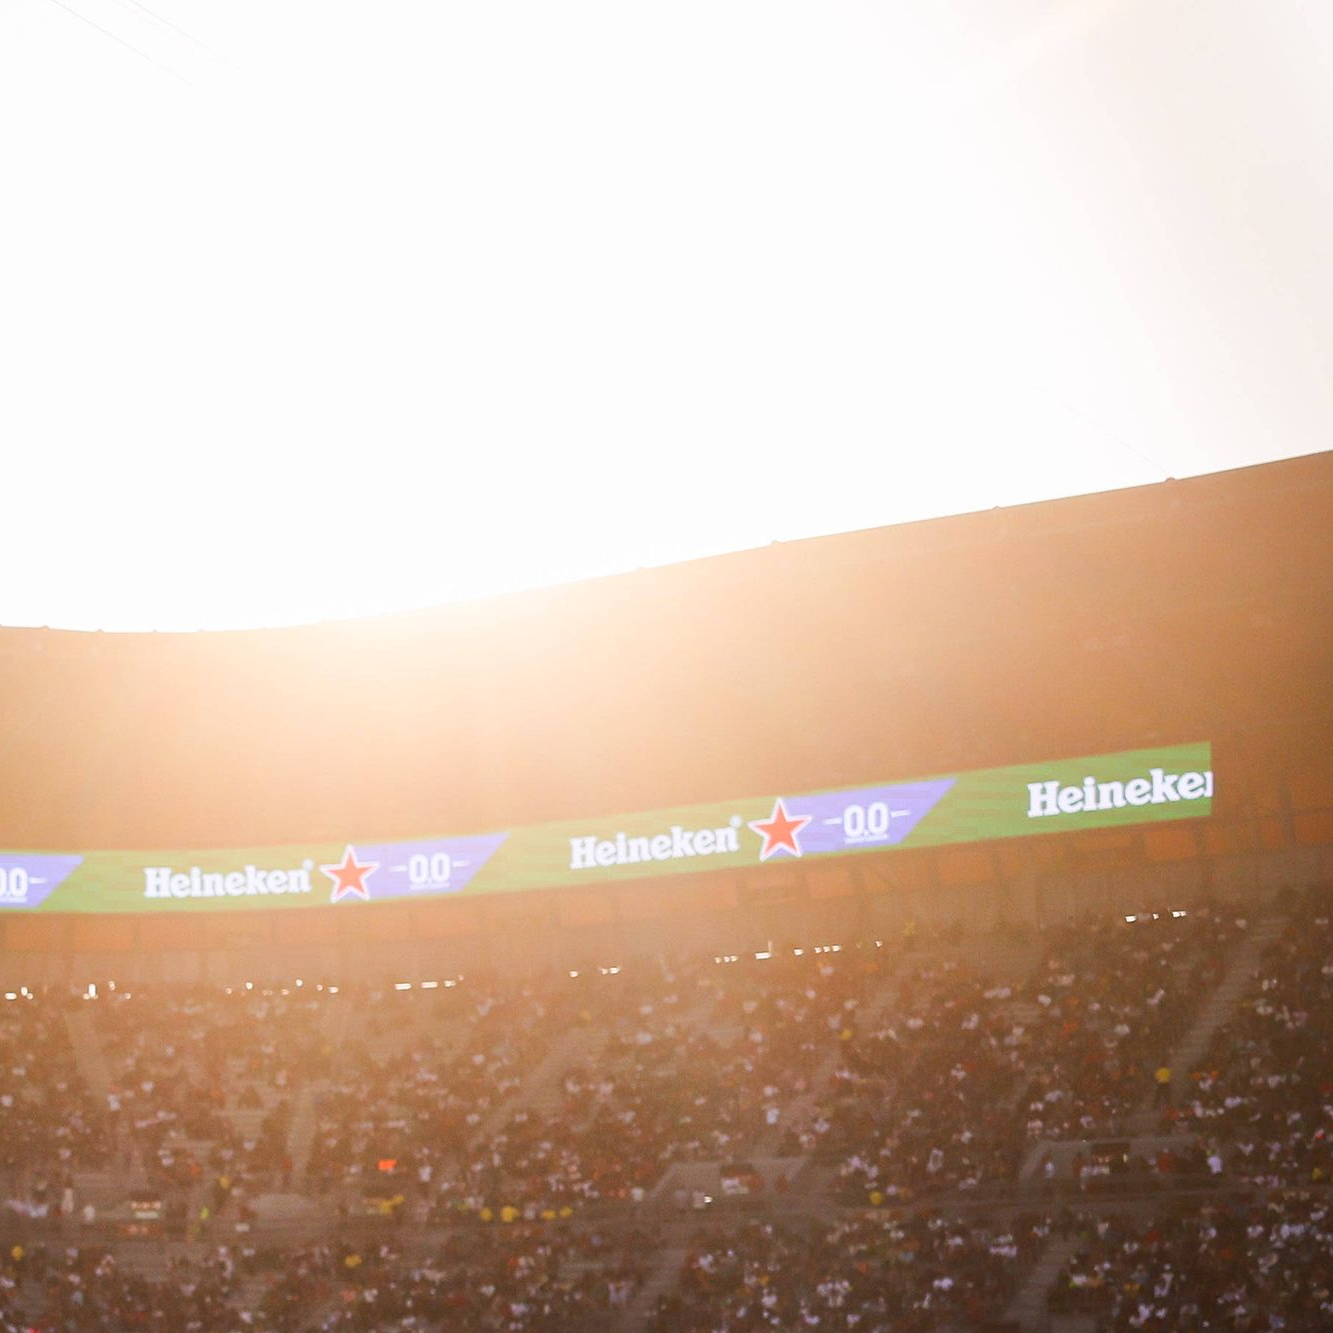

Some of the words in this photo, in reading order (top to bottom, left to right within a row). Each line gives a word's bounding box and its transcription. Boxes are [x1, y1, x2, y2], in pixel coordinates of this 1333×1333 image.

[569, 824, 740, 870] Heineken
[843, 801, 889, 838] 0.0
[143, 862, 313, 899] Heineken
